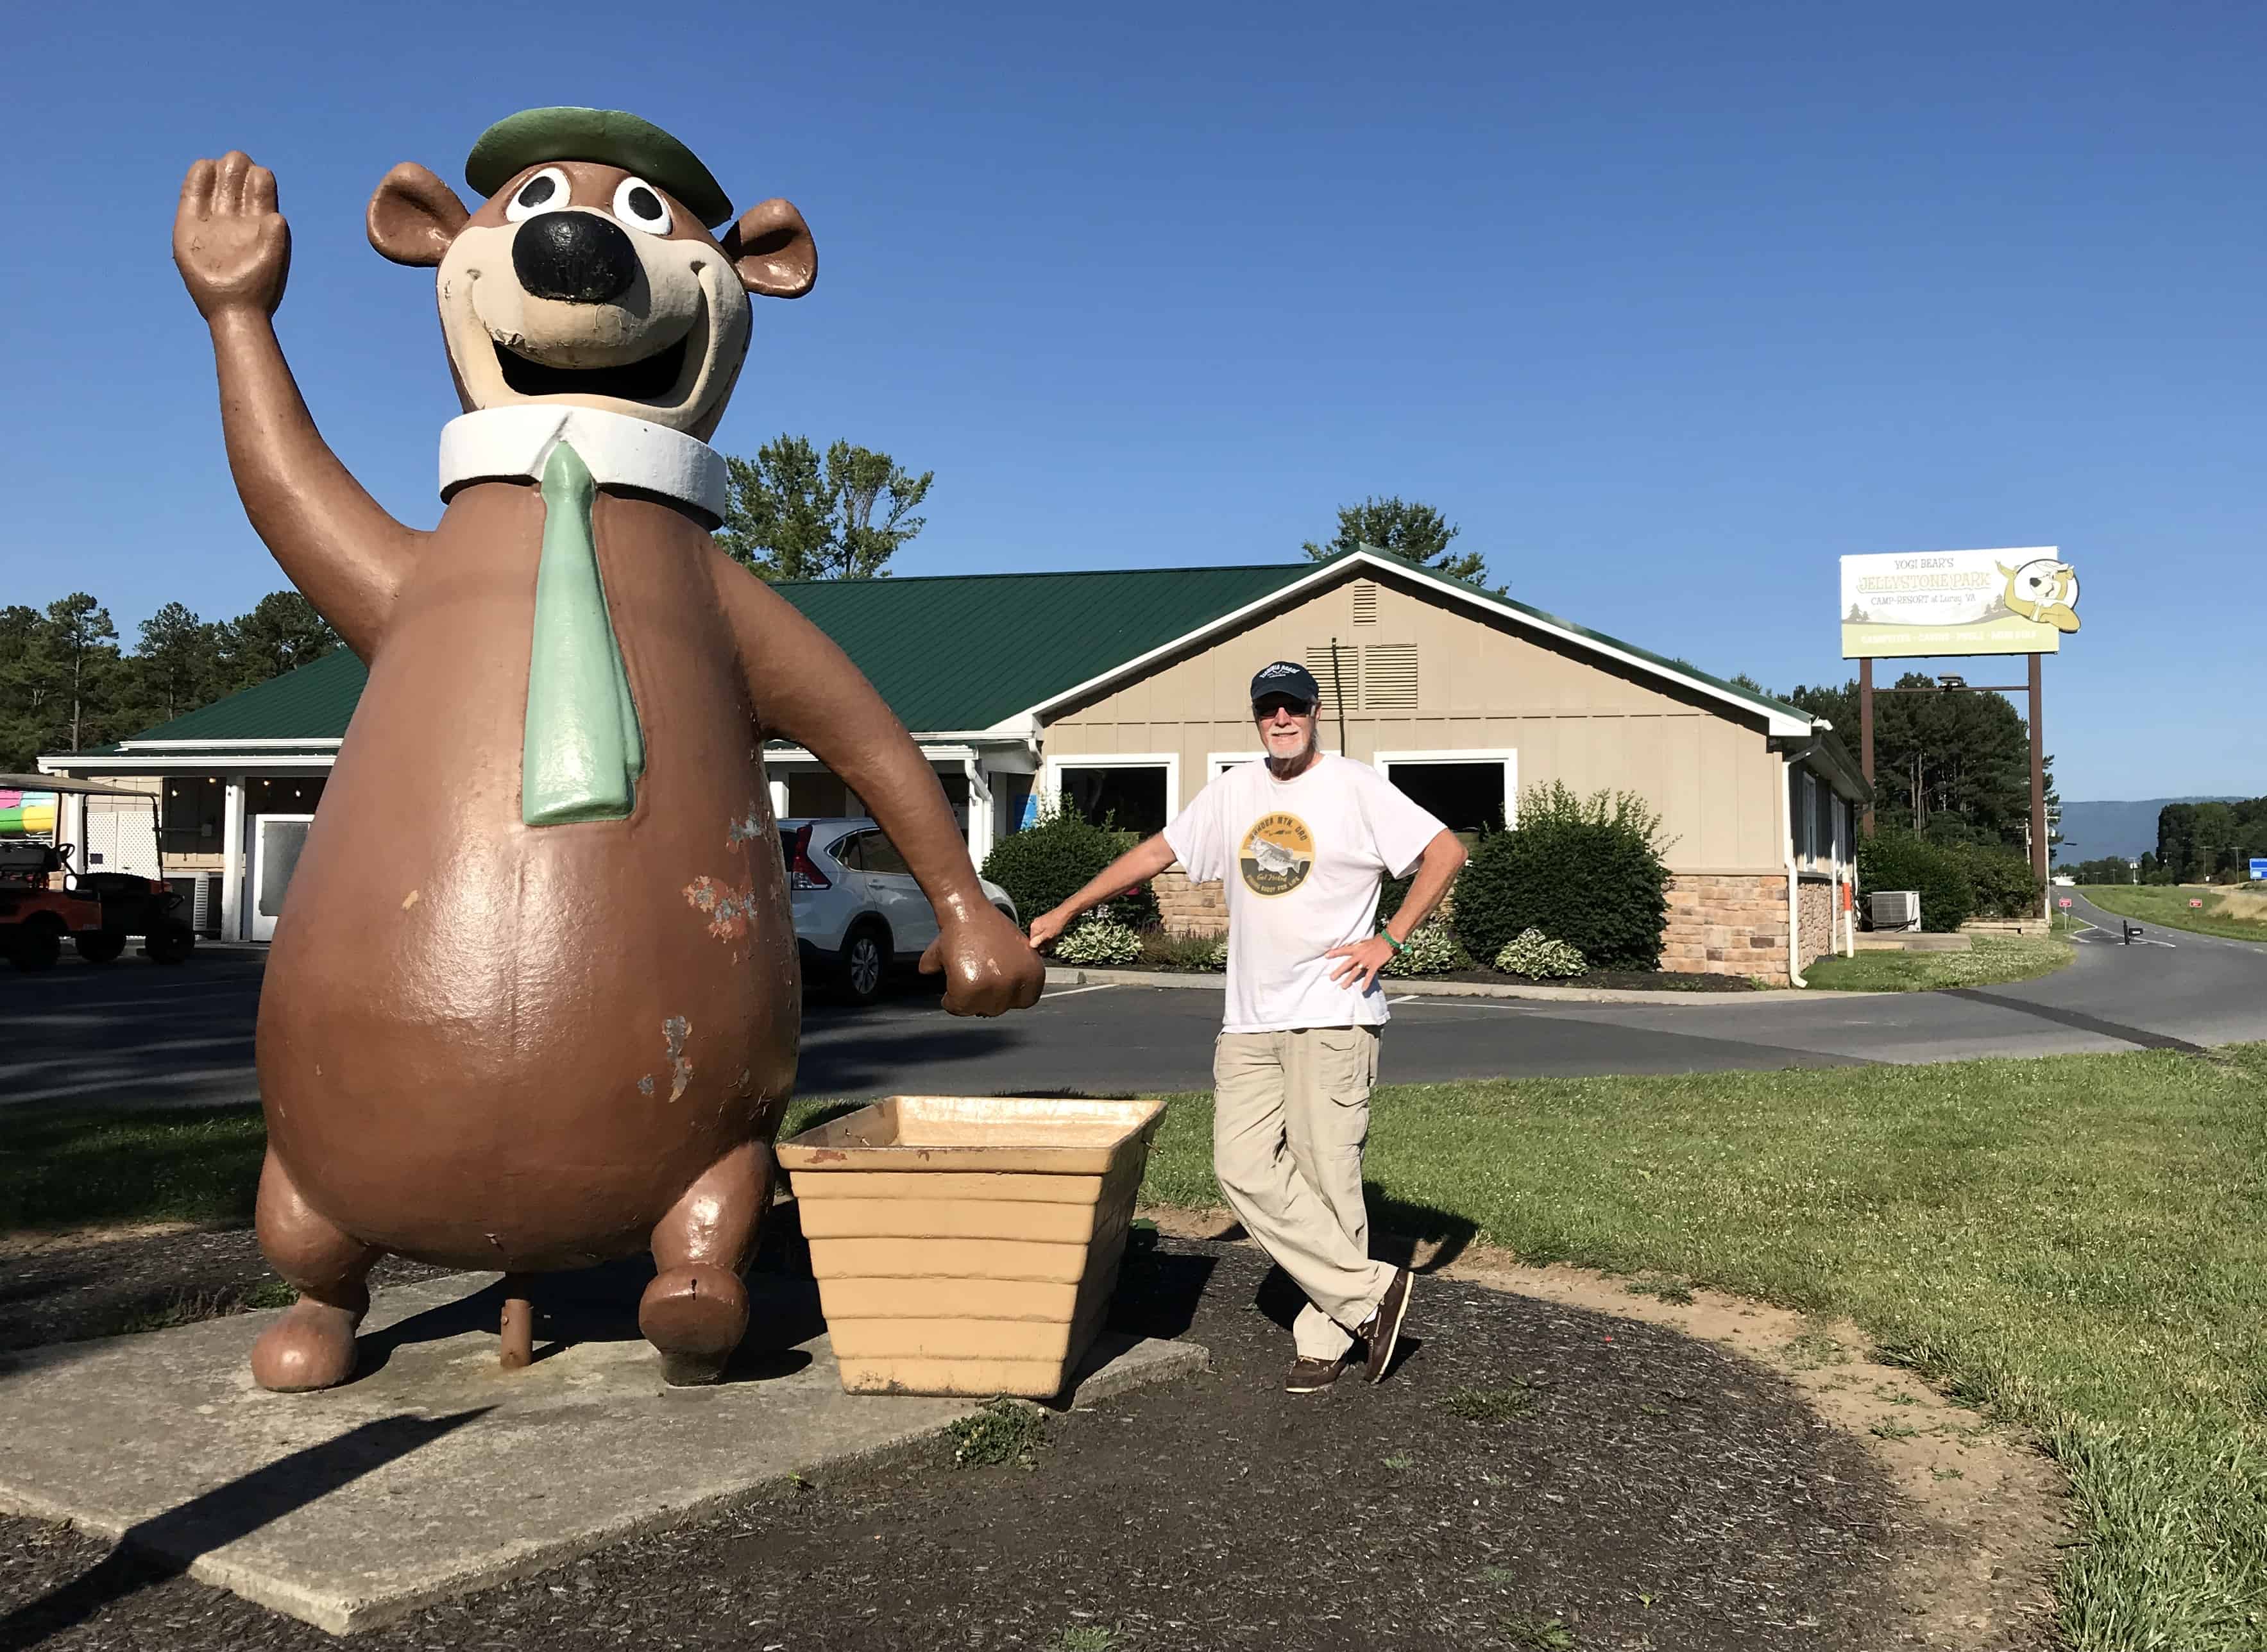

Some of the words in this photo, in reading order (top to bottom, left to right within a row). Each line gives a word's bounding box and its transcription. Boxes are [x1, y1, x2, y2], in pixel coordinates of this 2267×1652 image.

[1895, 559, 1918, 570] YOGI
[1921, 558, 1954, 568] BEAR'S
[1858, 575, 1949, 590] JELLYSTONE
[1951, 573, 1991, 586] PARK
[1871, 595, 1929, 605] CAMP-RESORT
[1966, 593, 1976, 602] VA
